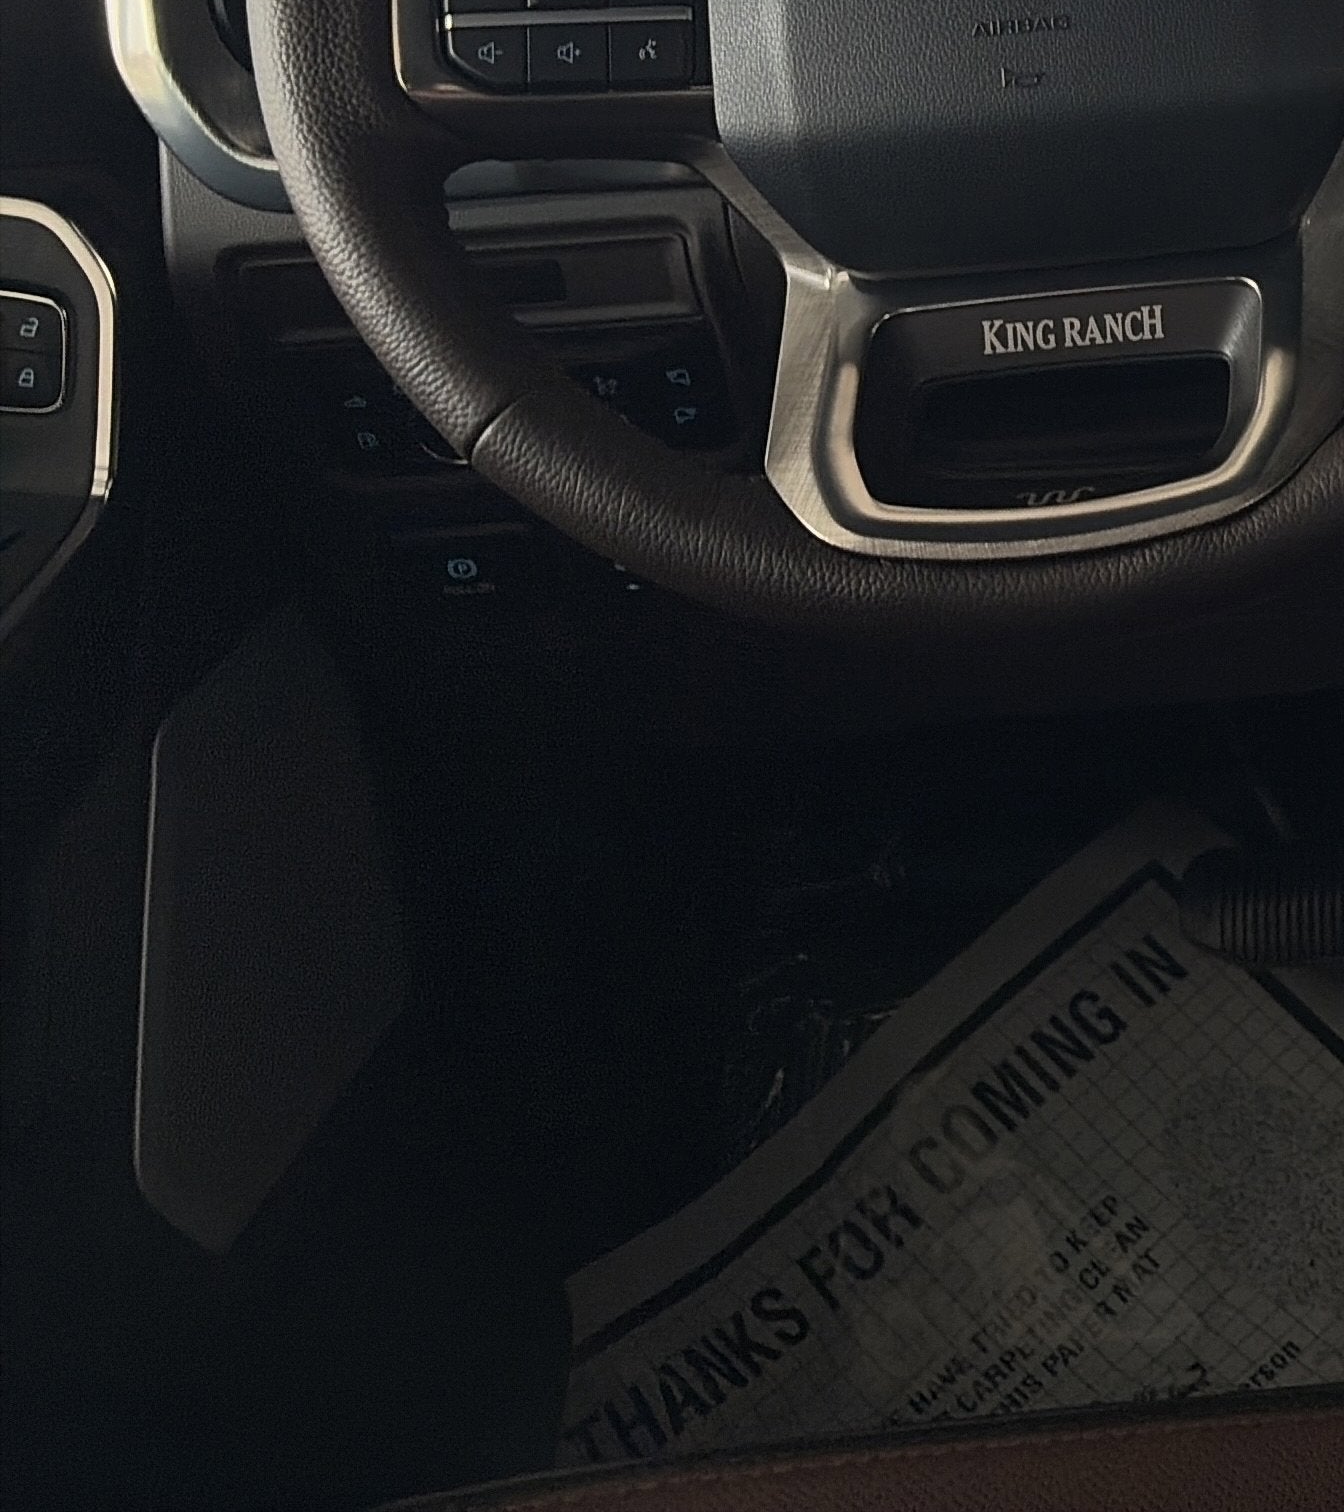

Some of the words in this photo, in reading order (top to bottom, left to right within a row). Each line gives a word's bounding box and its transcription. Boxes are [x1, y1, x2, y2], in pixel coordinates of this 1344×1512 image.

[971, 15, 1069, 37] AIRBAG
[982, 319, 1057, 355] KING
[1062, 304, 1165, 348] RANCH
[561, 1285, 811, 1462] THANKS
[795, 1184, 923, 1310] FOR
[909, 988, 1128, 1195] COMING
[1111, 934, 1190, 1009] IN
[1078, 1214, 1151, 1291] CLAN
